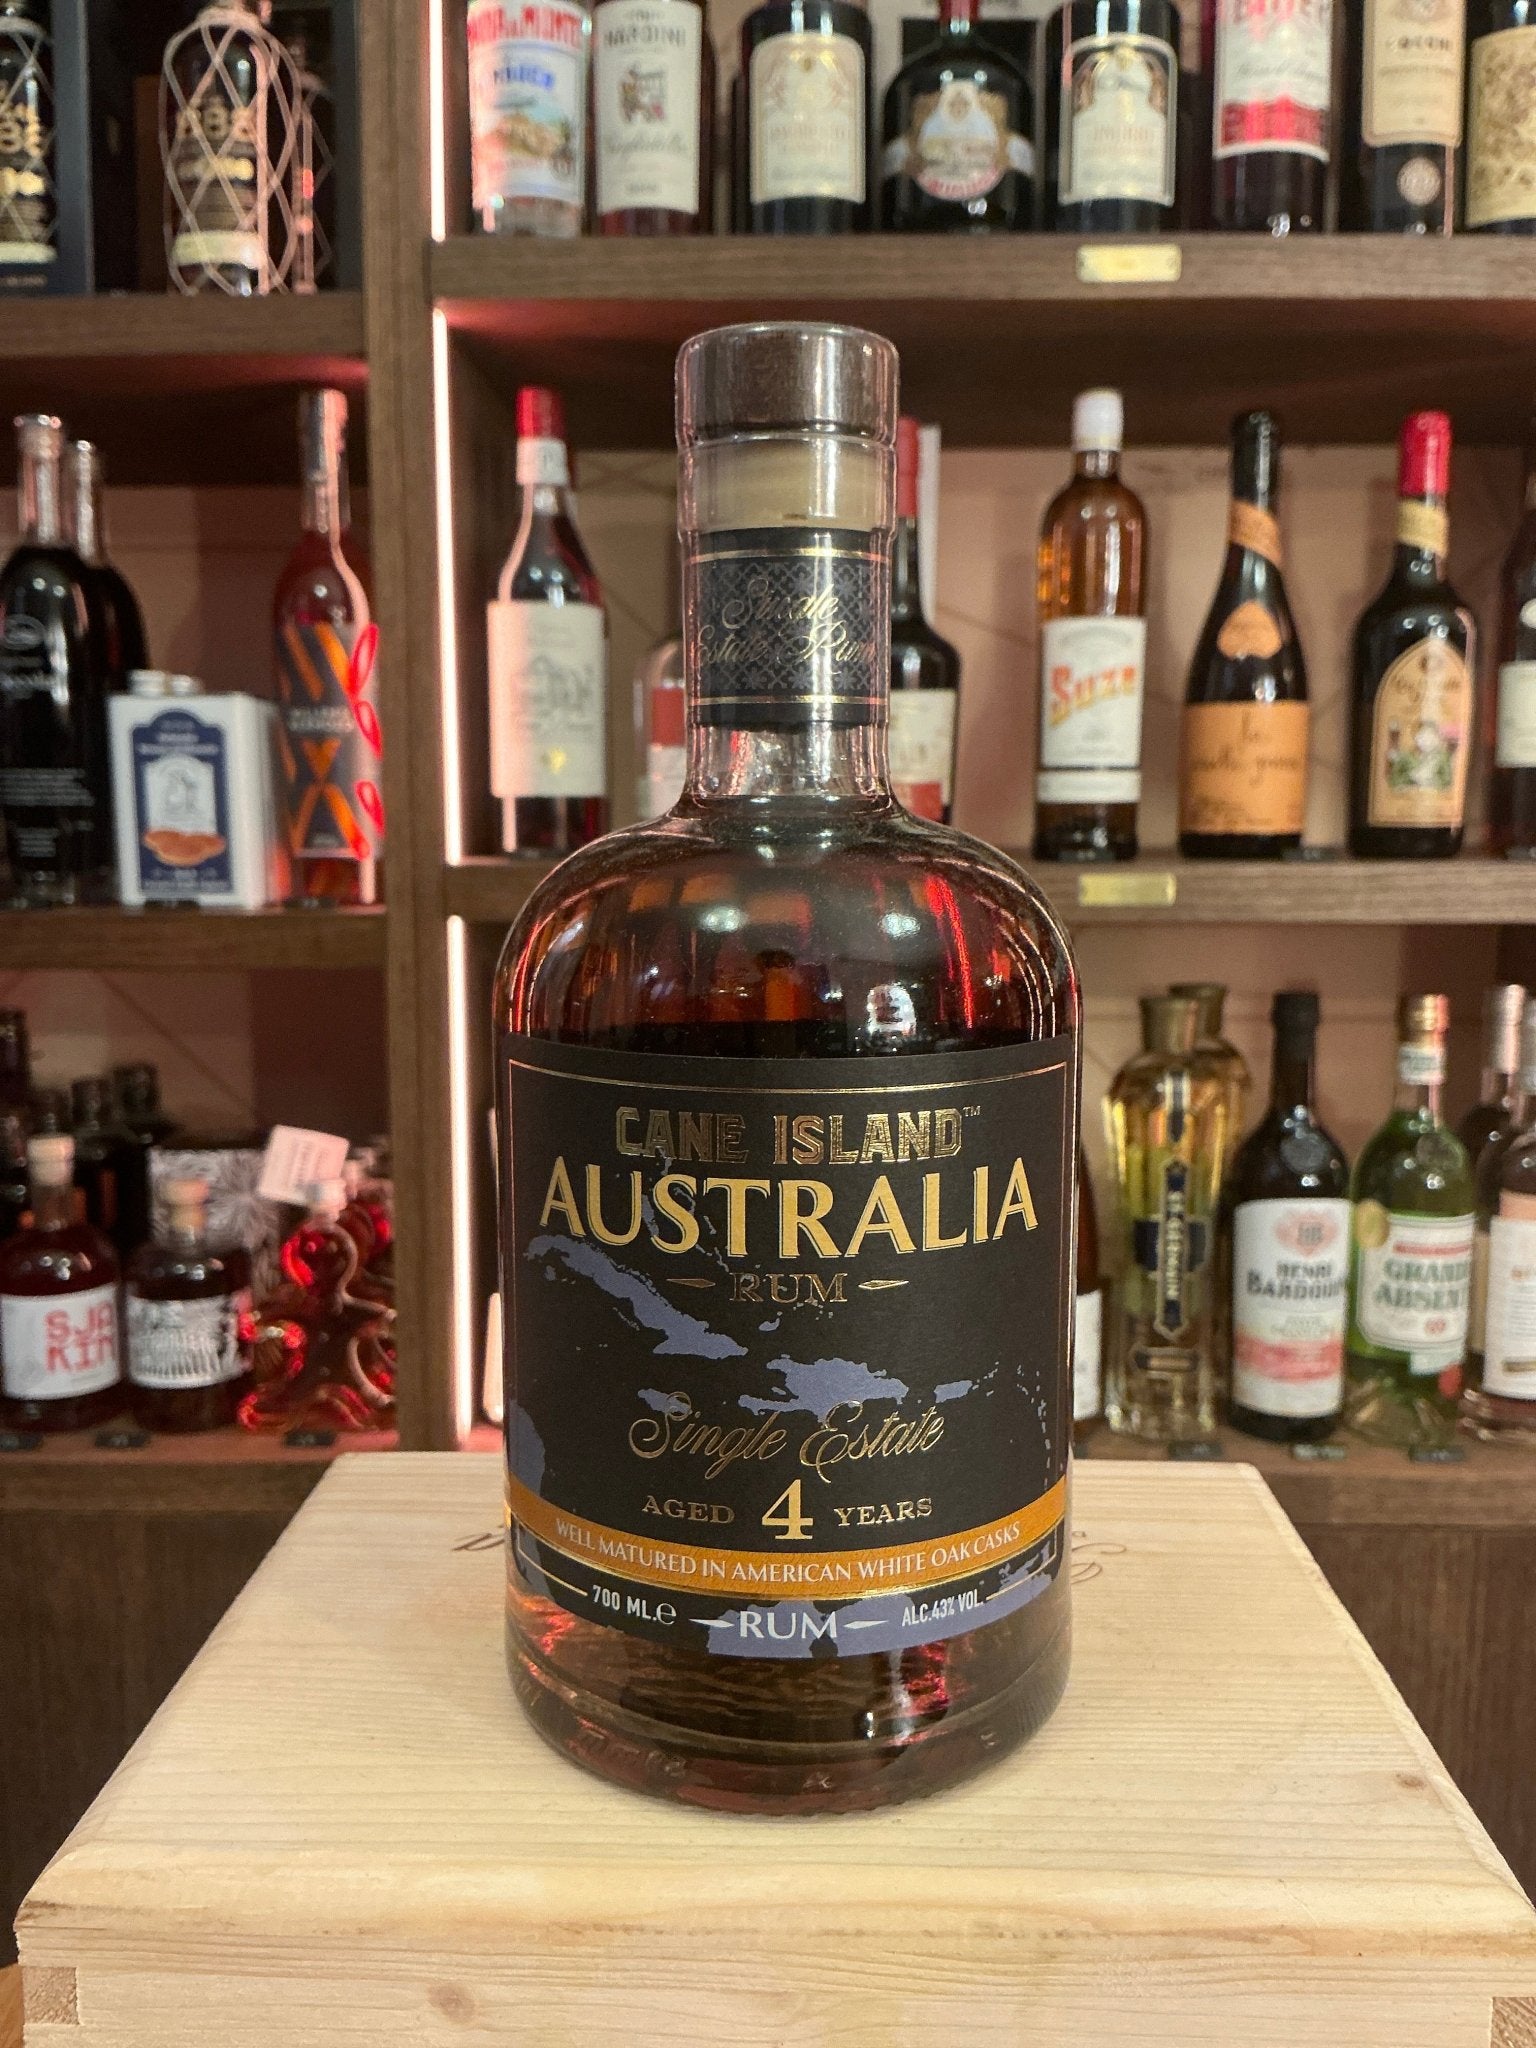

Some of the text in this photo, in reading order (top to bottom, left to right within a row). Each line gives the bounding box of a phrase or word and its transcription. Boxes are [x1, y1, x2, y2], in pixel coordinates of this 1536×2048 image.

[1049, 665, 1136, 729] Suze
[615, 1106, 748, 1165] CANE
[539, 1155, 1039, 1259] AUSTRALIA
[729, 1272, 848, 1303] RUM
[629, 1391, 945, 1484] Single Estate
[641, 1479, 933, 1540] AGED 4 YEARS
[556, 1518, 1021, 1583] WELL MATURED IN AMERICAN WHITE OAK CASKS
[592, 1585, 620, 1611] 700
[740, 1610, 837, 1639] RUM
[958, 1588, 984, 1612] VOL.
